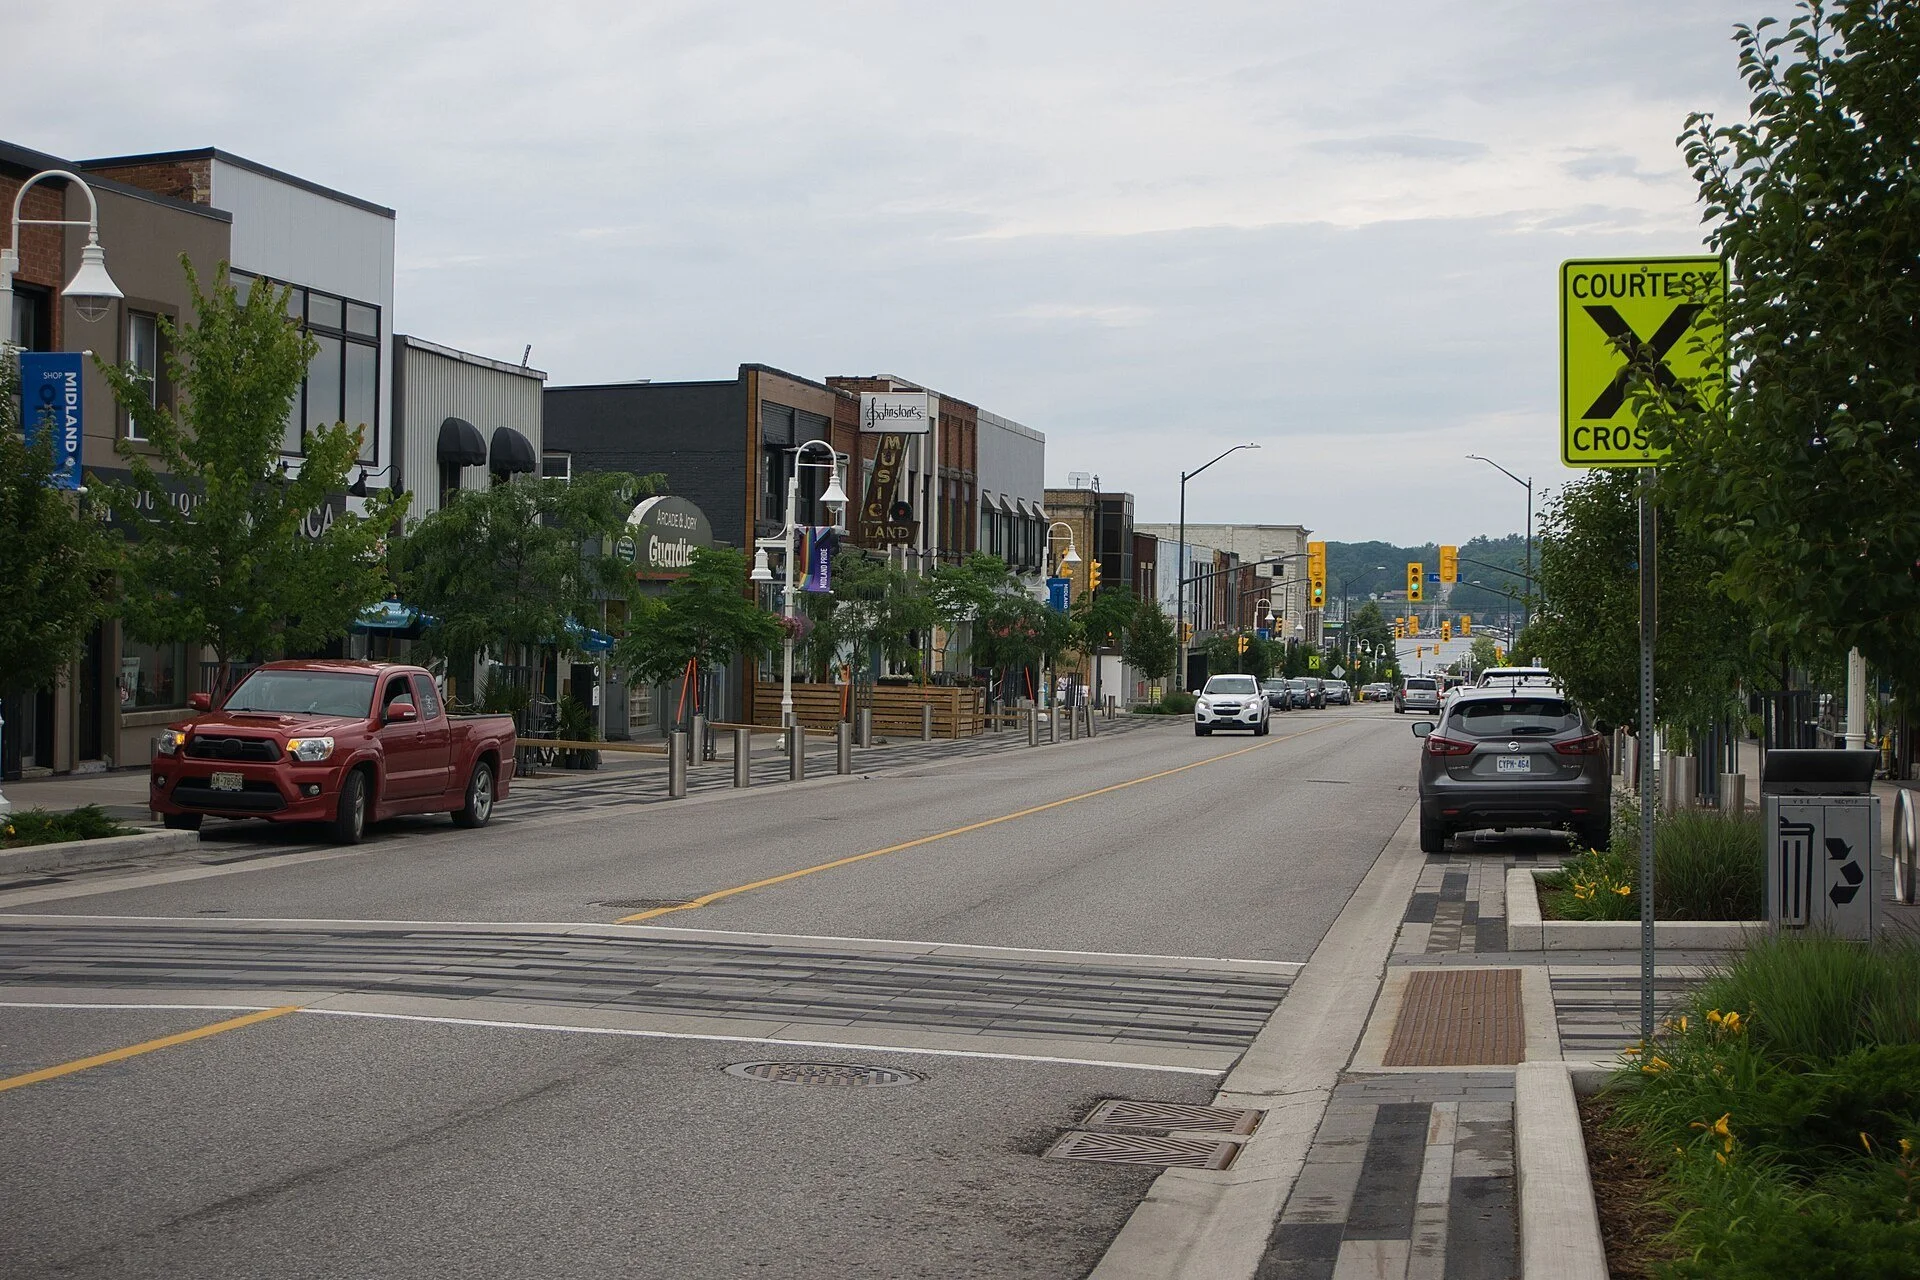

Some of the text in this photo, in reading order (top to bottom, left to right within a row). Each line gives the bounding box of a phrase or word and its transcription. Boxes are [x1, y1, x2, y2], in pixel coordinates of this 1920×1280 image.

[1573, 272, 1718, 298] COURTESY
[43, 371, 63, 380] SHOP
[64, 371, 78, 453] MIDLAND
[868, 435, 901, 517] MUSIC
[656, 509, 679, 528] ARCADE
[865, 527, 909, 538] LAND
[649, 534, 698, 568] Guardia
[820, 548, 828, 589] MIDLAND PRIDE
